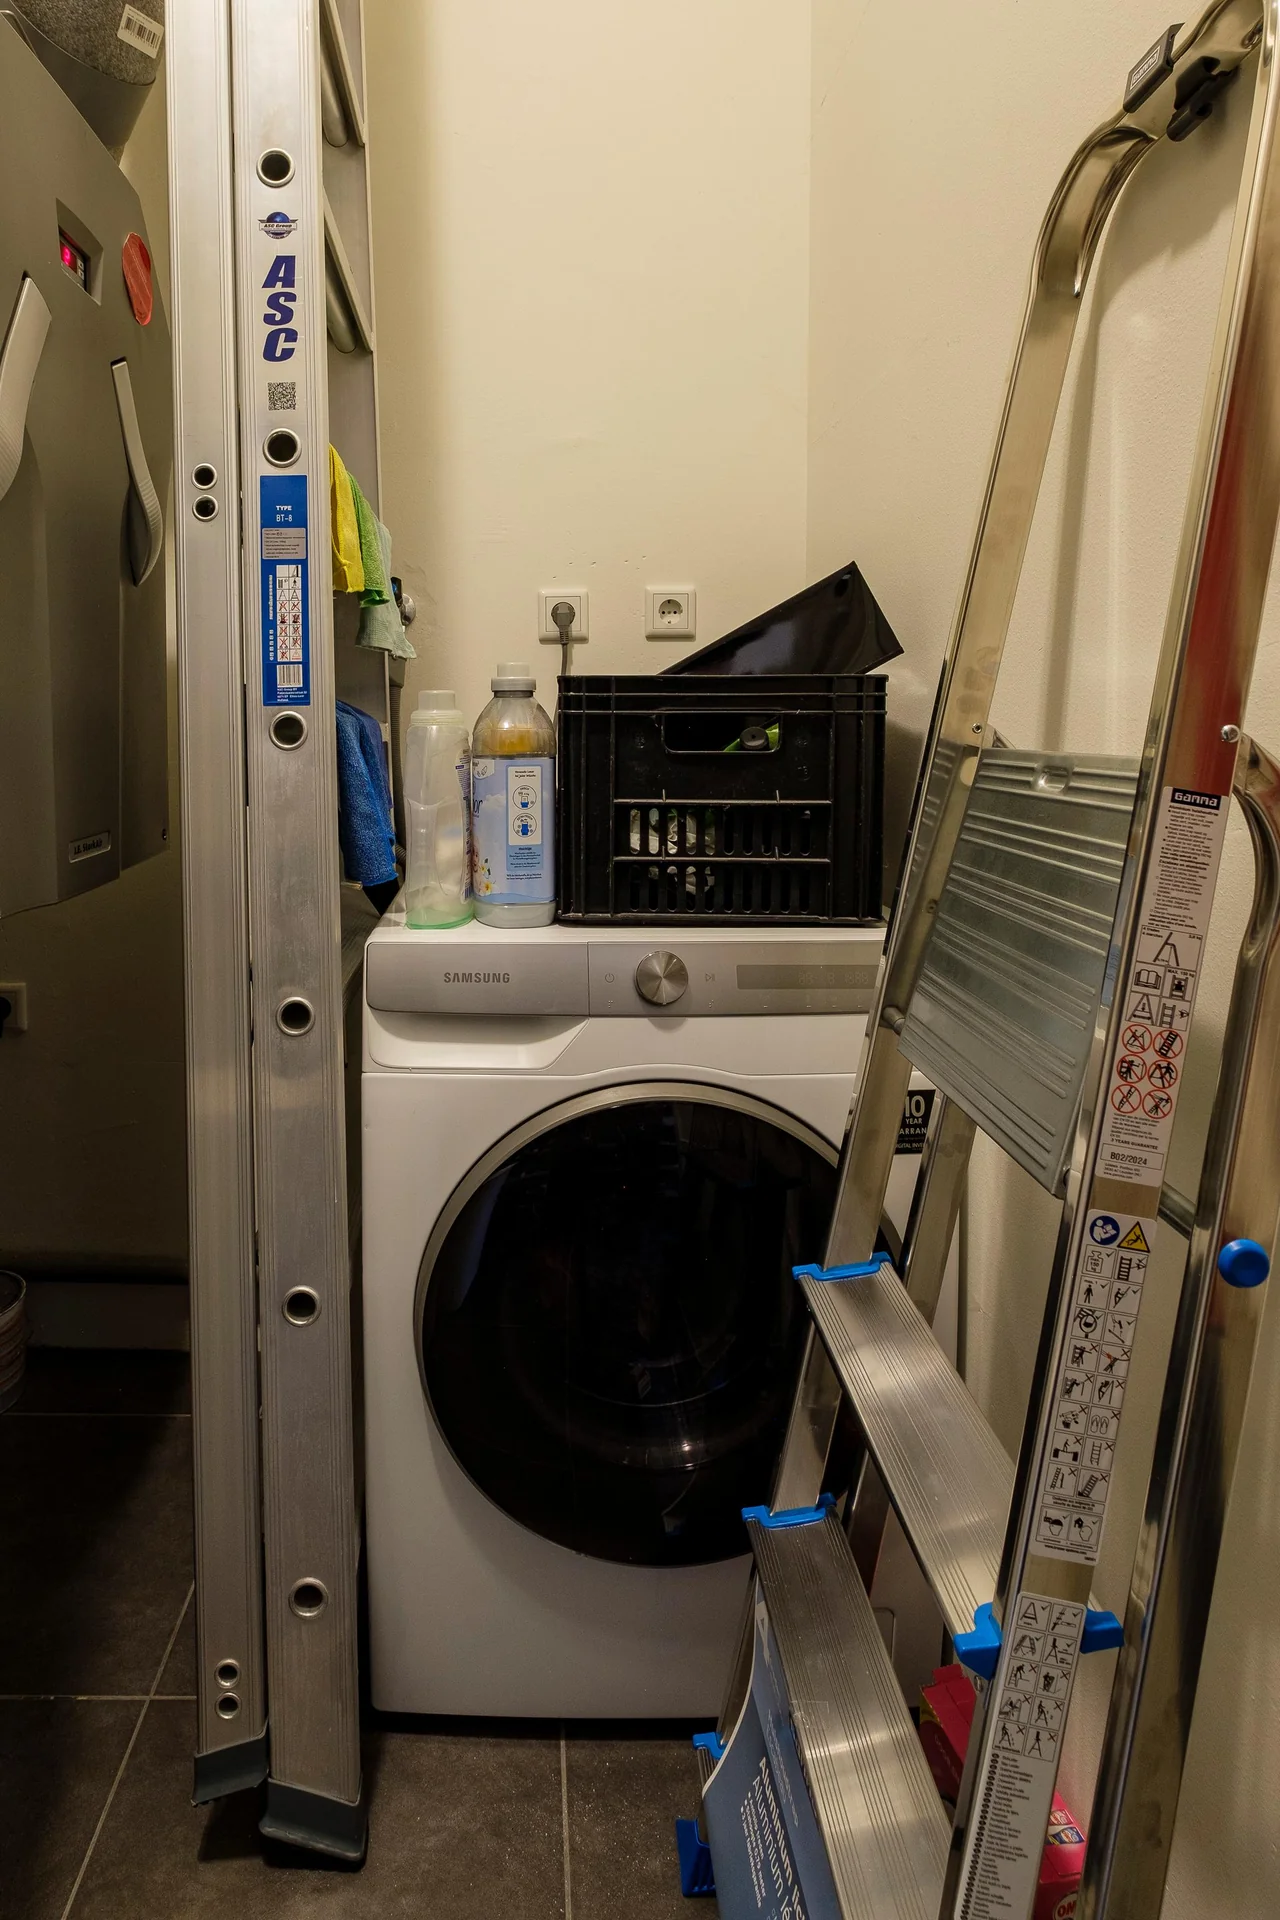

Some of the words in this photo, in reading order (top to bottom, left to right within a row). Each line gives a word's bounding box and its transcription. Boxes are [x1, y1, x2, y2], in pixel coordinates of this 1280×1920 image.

[262, 256, 298, 362] ASC
[444, 972, 510, 983] SAMSUNG
[905, 1095, 925, 1117] 10
[1130, 1140, 1158, 1150] GUARANTEE
[1109, 1151, 1148, 1165] B02/2024
[759, 1757, 792, 1887] Aluminium
[753, 1776, 784, 1898] Aluminium
[758, 1870, 766, 1896] meter
